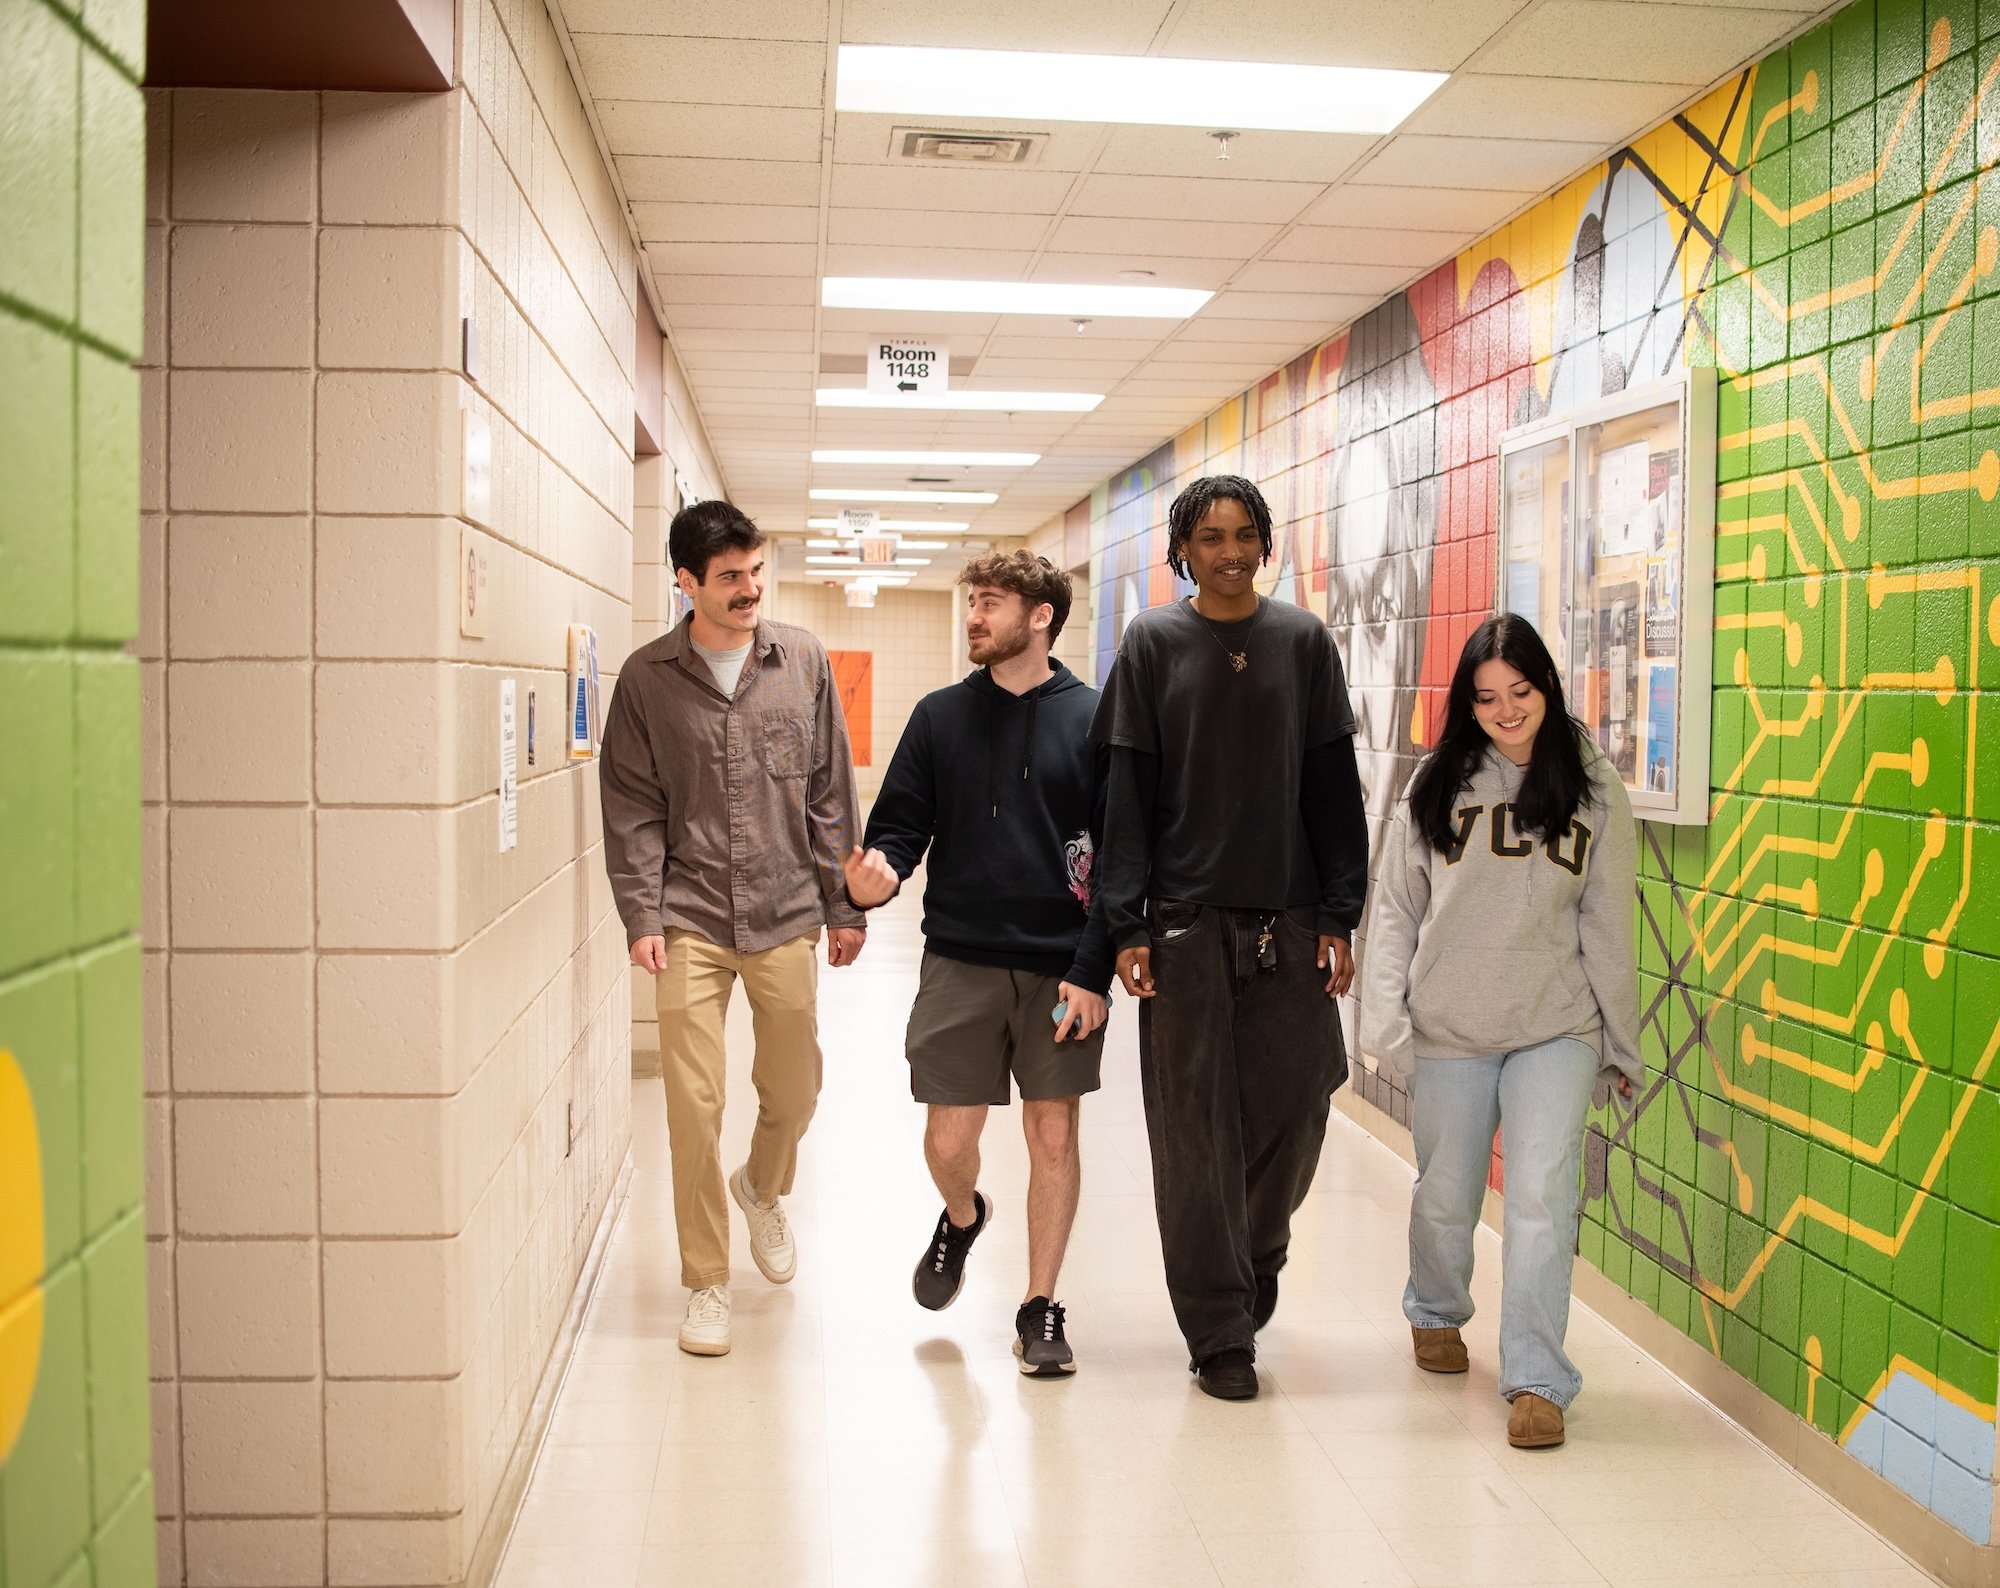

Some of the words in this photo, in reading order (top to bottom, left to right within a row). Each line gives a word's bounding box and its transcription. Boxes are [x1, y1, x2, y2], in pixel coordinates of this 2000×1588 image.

[880, 344, 936, 361] Room
[887, 362, 929, 378] 1148
[843, 509, 873, 518] Room
[863, 541, 892, 562] EXIT
